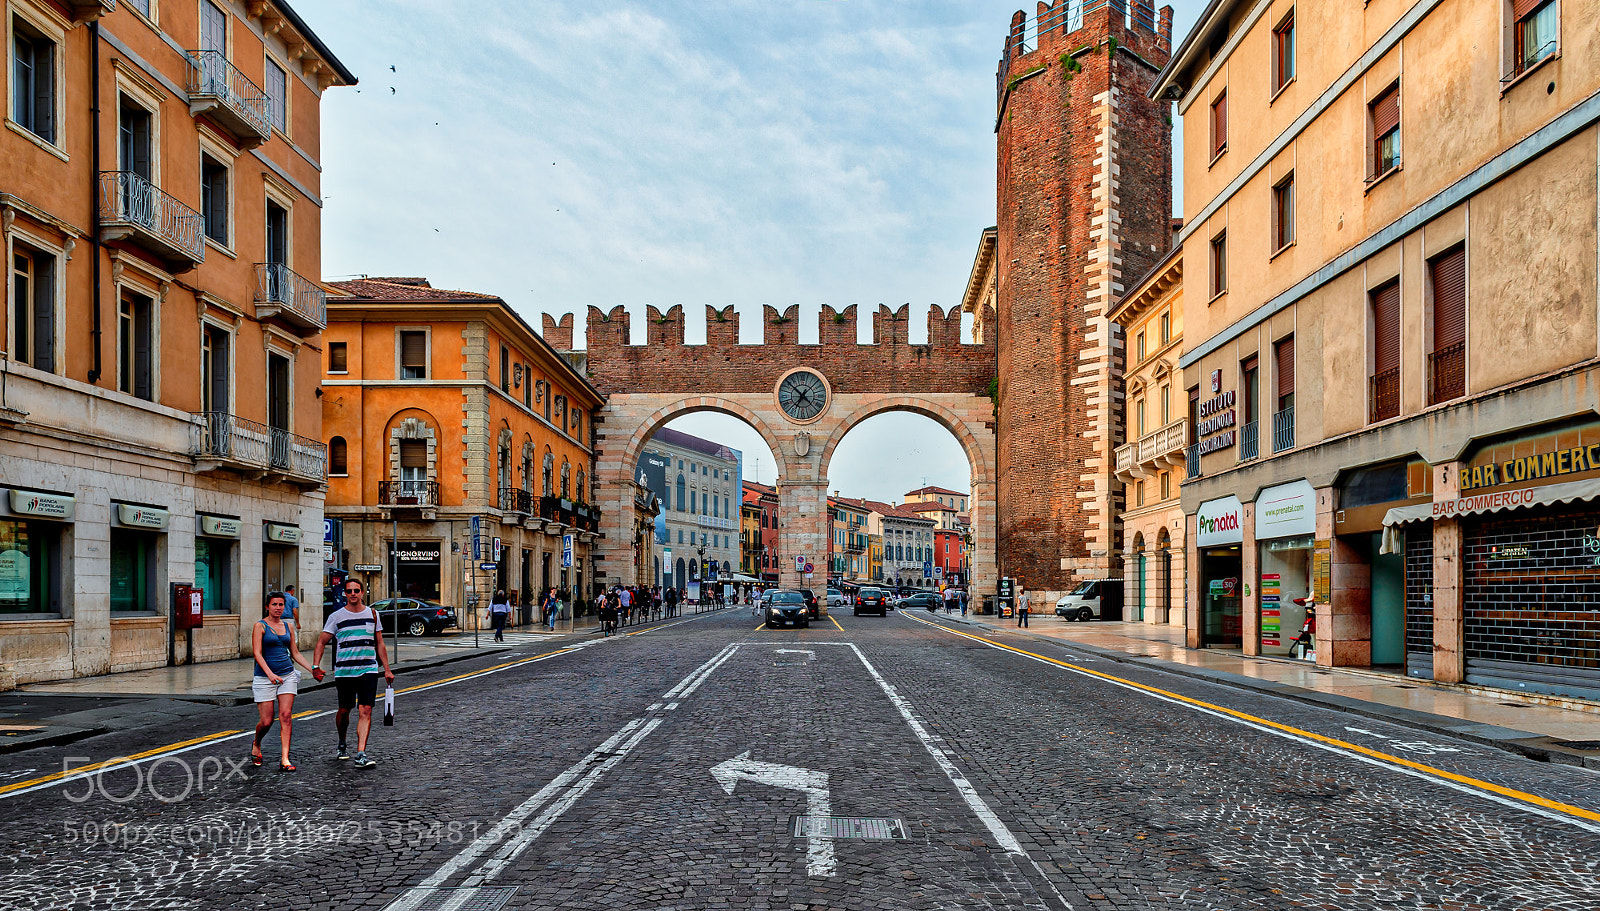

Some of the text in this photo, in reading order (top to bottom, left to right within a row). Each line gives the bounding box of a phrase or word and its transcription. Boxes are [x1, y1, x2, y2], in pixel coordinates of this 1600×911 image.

[1200, 390, 1233, 417] ISTITUTO
[1460, 464, 1496, 490] BAR
[1265, 504, 1304, 517] www.prenatal.com
[1433, 489, 1534, 515] BAR COMMERCIO
[323, 521, 331, 539] P
[1501, 547, 1528, 556] SPATEN
[1224, 581, 1233, 589] 30
